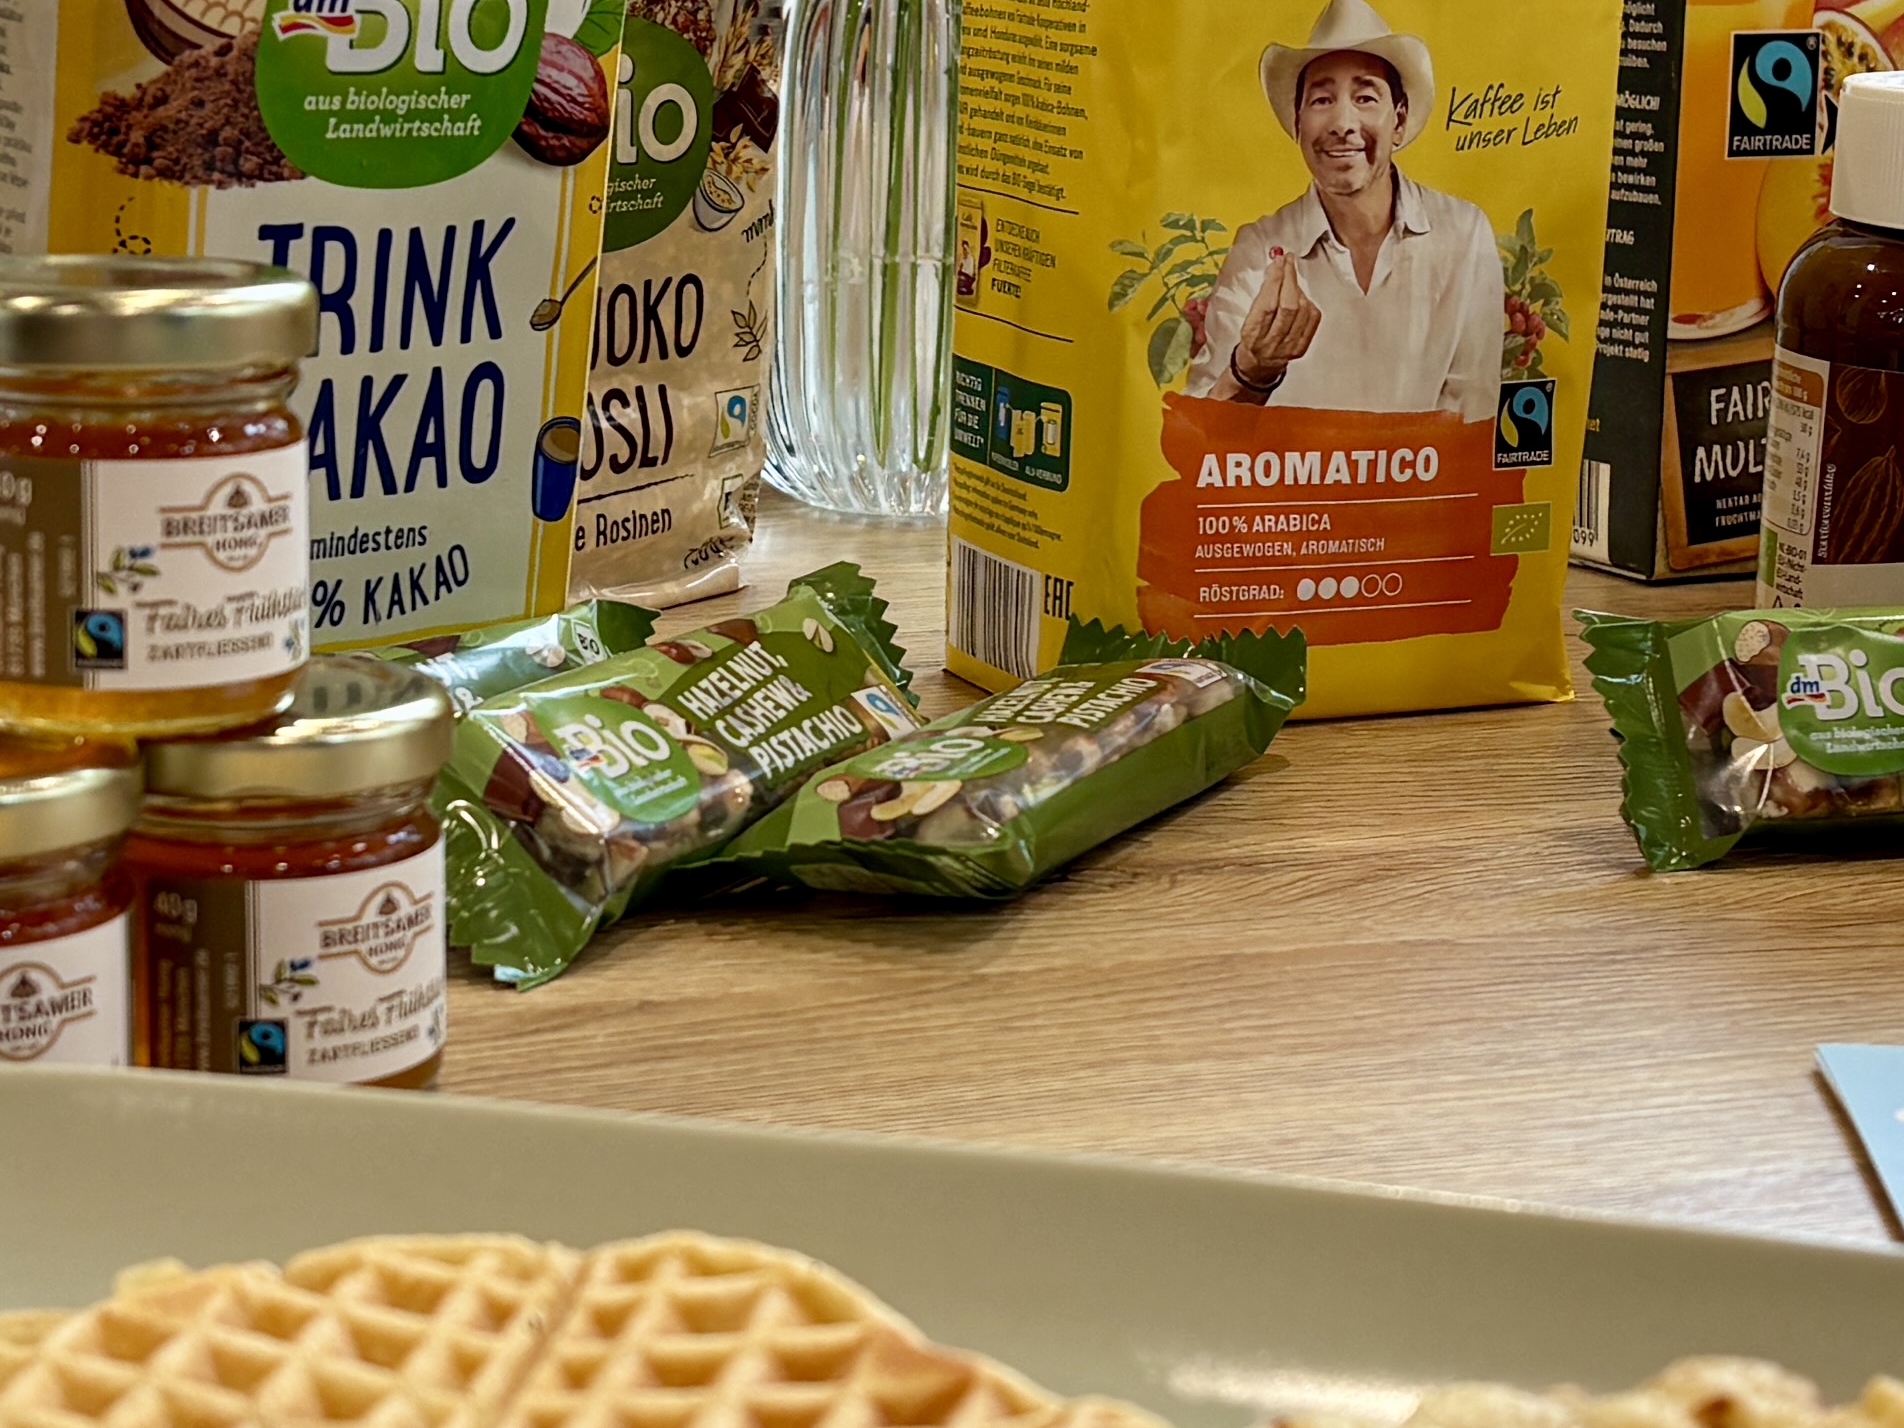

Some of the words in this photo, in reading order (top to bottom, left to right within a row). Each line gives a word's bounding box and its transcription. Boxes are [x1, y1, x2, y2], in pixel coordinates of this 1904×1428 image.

[303, 91, 341, 112] aus
[345, 86, 472, 117] biologischer
[615, 52, 699, 164] io
[1447, 88, 1526, 131] Kaffee
[1534, 83, 1562, 112] ist
[324, 114, 484, 140] Landwirtschaft
[1454, 122, 1518, 153] unser
[1520, 114, 1580, 148] Leben
[1732, 134, 1812, 153] FAIRTRADE
[605, 174, 657, 196] gischer
[257, 215, 518, 356] TRINK
[590, 272, 705, 373] OKO
[308, 360, 506, 502] AKAO
[1196, 445, 1440, 490] AROMATICO
[1496, 449, 1550, 465] FAIRTRADE
[309, 524, 428, 561] mindestens
[595, 505, 674, 553] Rosinen
[1251, 512, 1332, 534] ARABICA
[1194, 539, 1297, 560] AUSGEWOGEN,
[1299, 535, 1386, 556] AROMATISCH
[362, 543, 470, 625] KAKAO
[1198, 580, 1286, 604] RÖSTGRAD:
[677, 640, 789, 722] HAZELNUT,
[1787, 676, 1822, 698] dm
[1054, 676, 1159, 729] PISTACHIO
[747, 704, 865, 778] PISTACHIO
